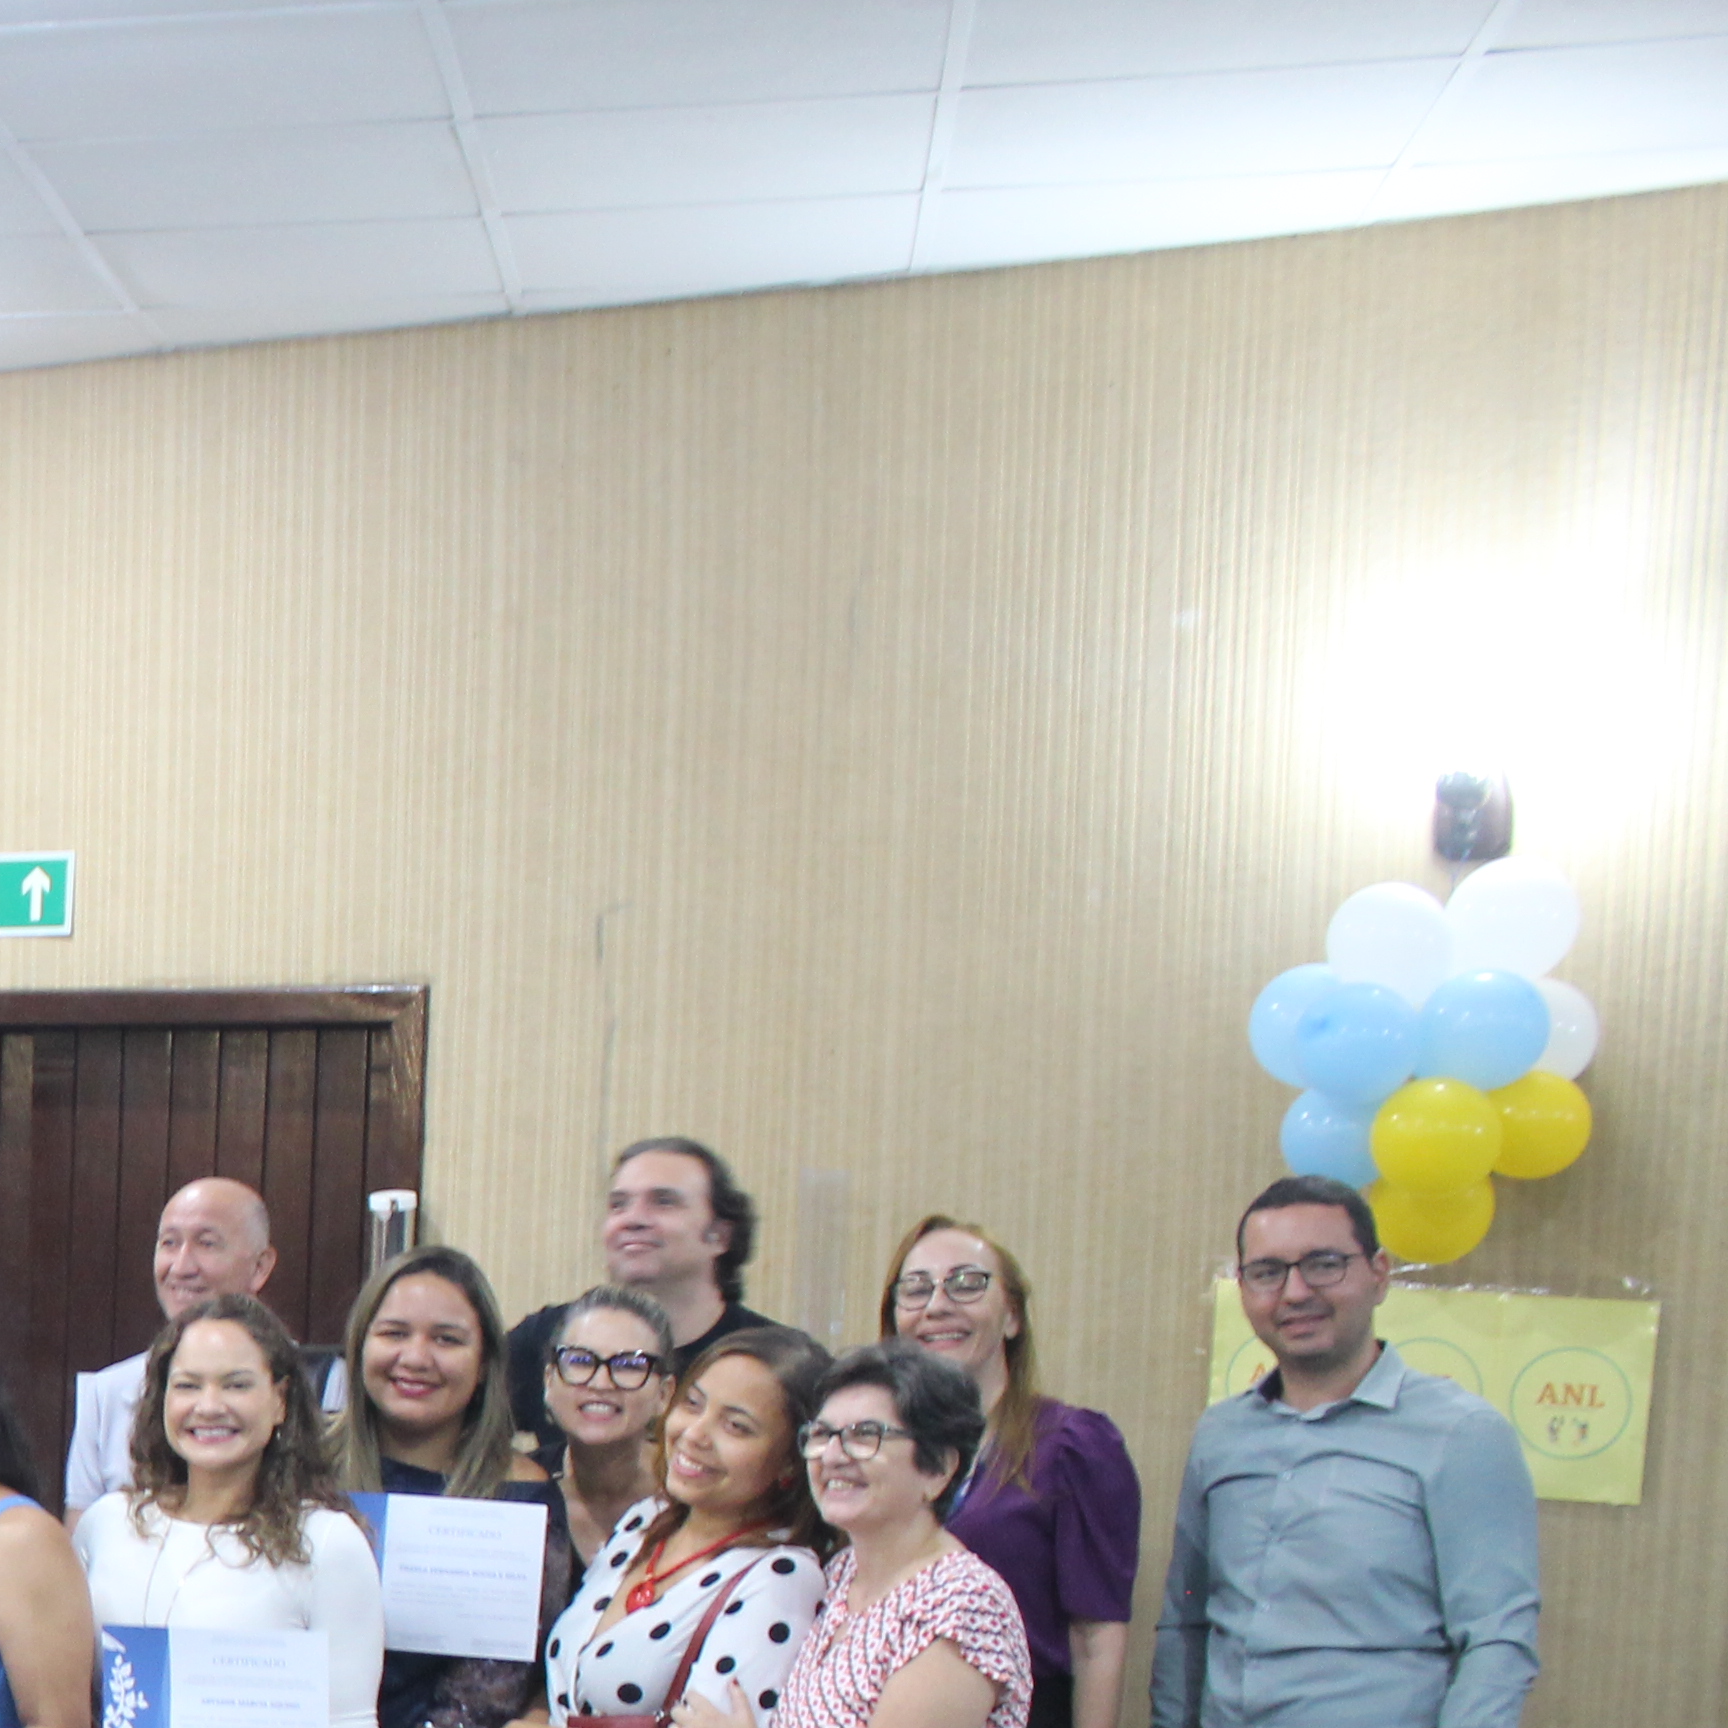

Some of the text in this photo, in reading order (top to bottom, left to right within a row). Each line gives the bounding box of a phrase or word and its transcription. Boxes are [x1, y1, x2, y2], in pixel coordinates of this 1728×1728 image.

[1536, 1381, 1606, 1408] ANL
[428, 1526, 503, 1540] CERTIFICADO
[212, 1656, 287, 1669] CERTIFICADO
